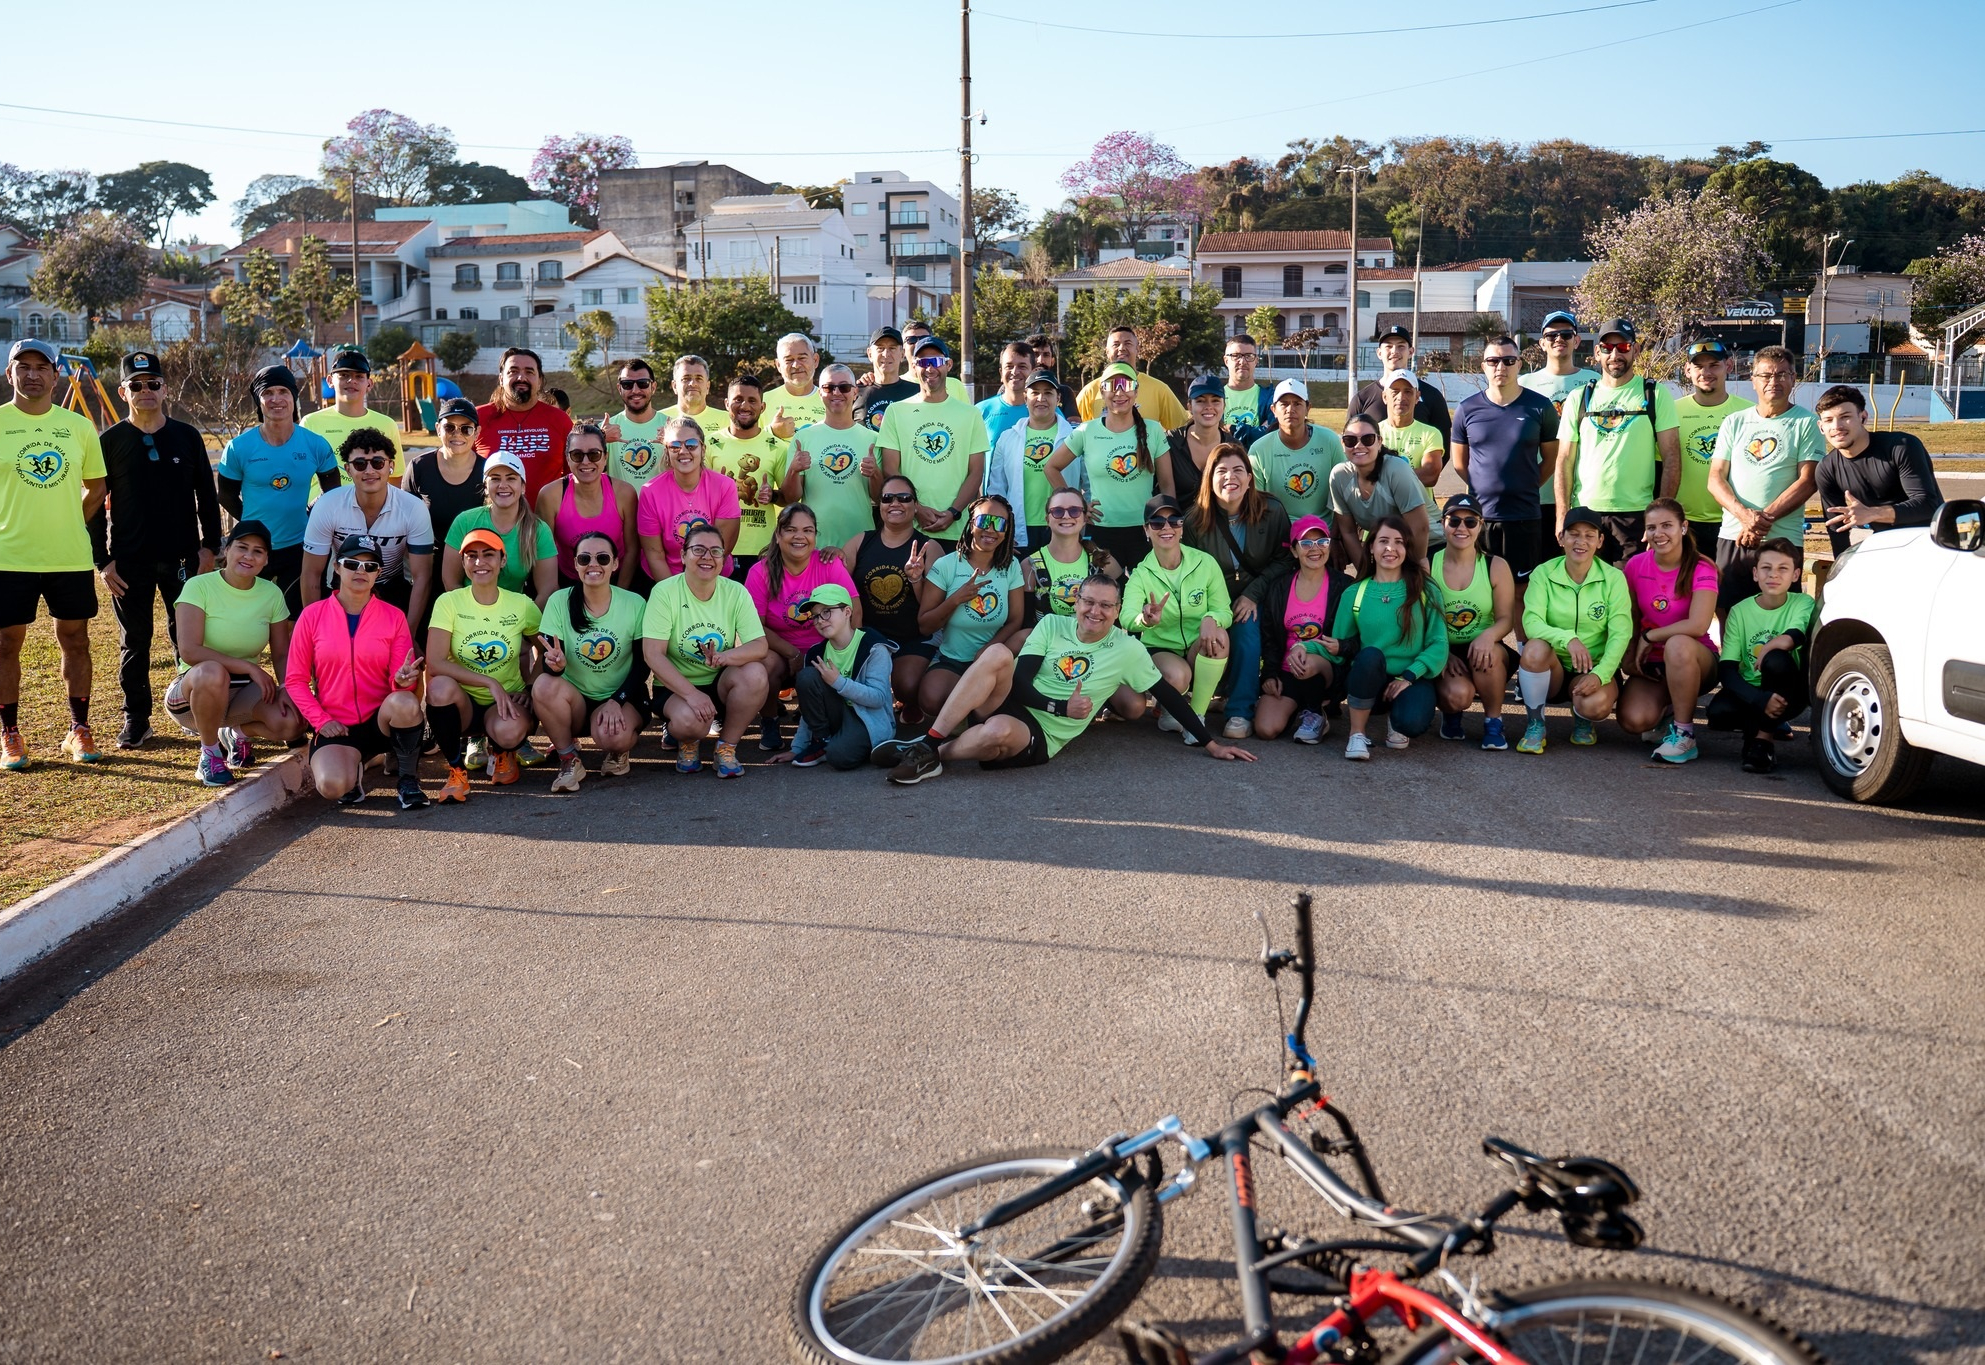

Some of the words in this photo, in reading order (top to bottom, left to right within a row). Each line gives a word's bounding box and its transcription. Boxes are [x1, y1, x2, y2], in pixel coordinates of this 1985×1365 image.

[1726, 307, 1776, 317] VEÍCULOS
[868, 400, 889, 414] CORRIDA
[915, 422, 935, 437] CORRIDA
[945, 425, 954, 437] RUA
[1688, 425, 1710, 439] CORRIDA
[17, 441, 41, 459] CORRIDA
[54, 445, 66, 457] RUA
[821, 444, 841, 455] CORRIDA
[849, 448, 857, 456] RUA
[918, 454, 932, 464] JUNTO
[937, 441, 955, 464] MISTURADO
[1107, 445, 1126, 459] CORRIDA
[15, 463, 25, 479] TUDO
[23, 478, 43, 489] JUNTO
[49, 461, 70, 488] MISTURADO
[674, 509, 693, 524] CORRIDA
[702, 512, 711, 522] RUA
[865, 565, 890, 580] CORRIDA
[898, 570, 907, 581] RUA
[1472, 604, 1481, 613] RUA
[462, 630, 488, 645] CORRIDA
[500, 634, 511, 645] RUA
[609, 631, 619, 642] RUA
[682, 622, 705, 639] CORRIDA
[717, 627, 726, 637] RUA
[465, 663, 482, 674] JUNTO
[488, 649, 515, 674] MISTURADO
